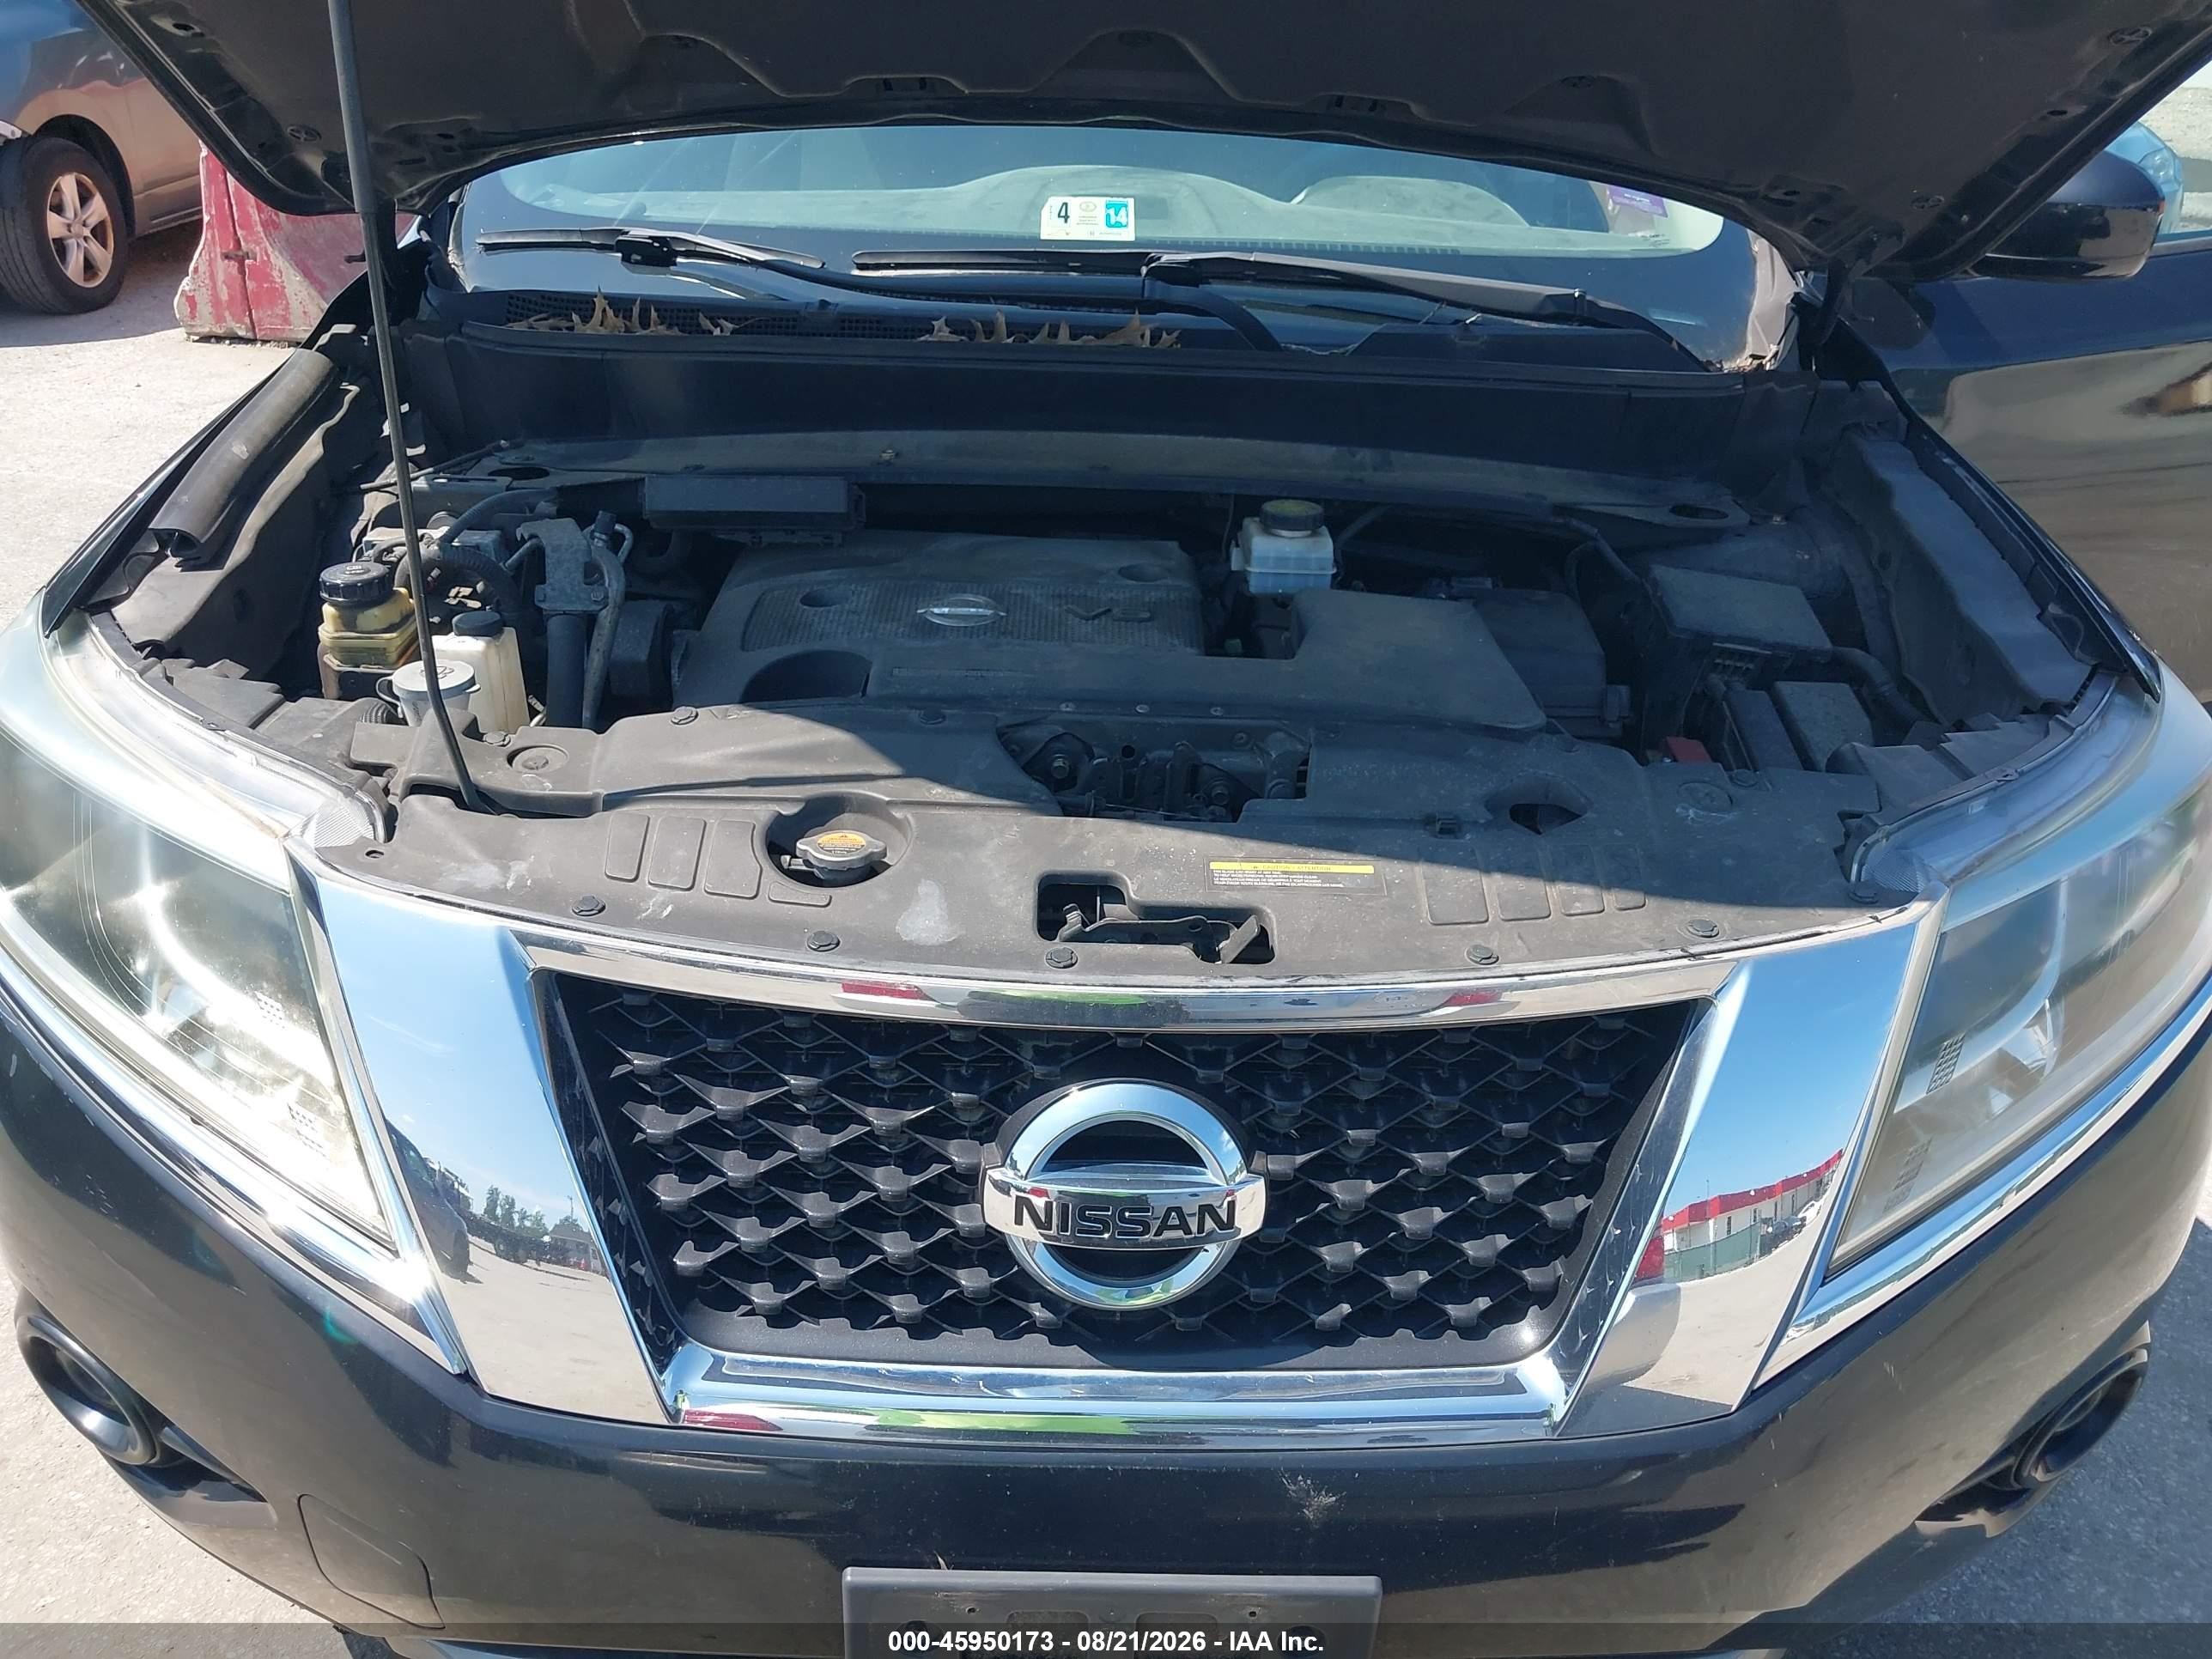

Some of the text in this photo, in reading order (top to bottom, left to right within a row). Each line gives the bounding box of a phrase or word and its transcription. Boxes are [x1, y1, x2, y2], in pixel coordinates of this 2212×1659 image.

[1057, 202, 1070, 224] 4
[1106, 204, 1127, 227] 14
[1013, 1194, 1237, 1239] NISSAN
